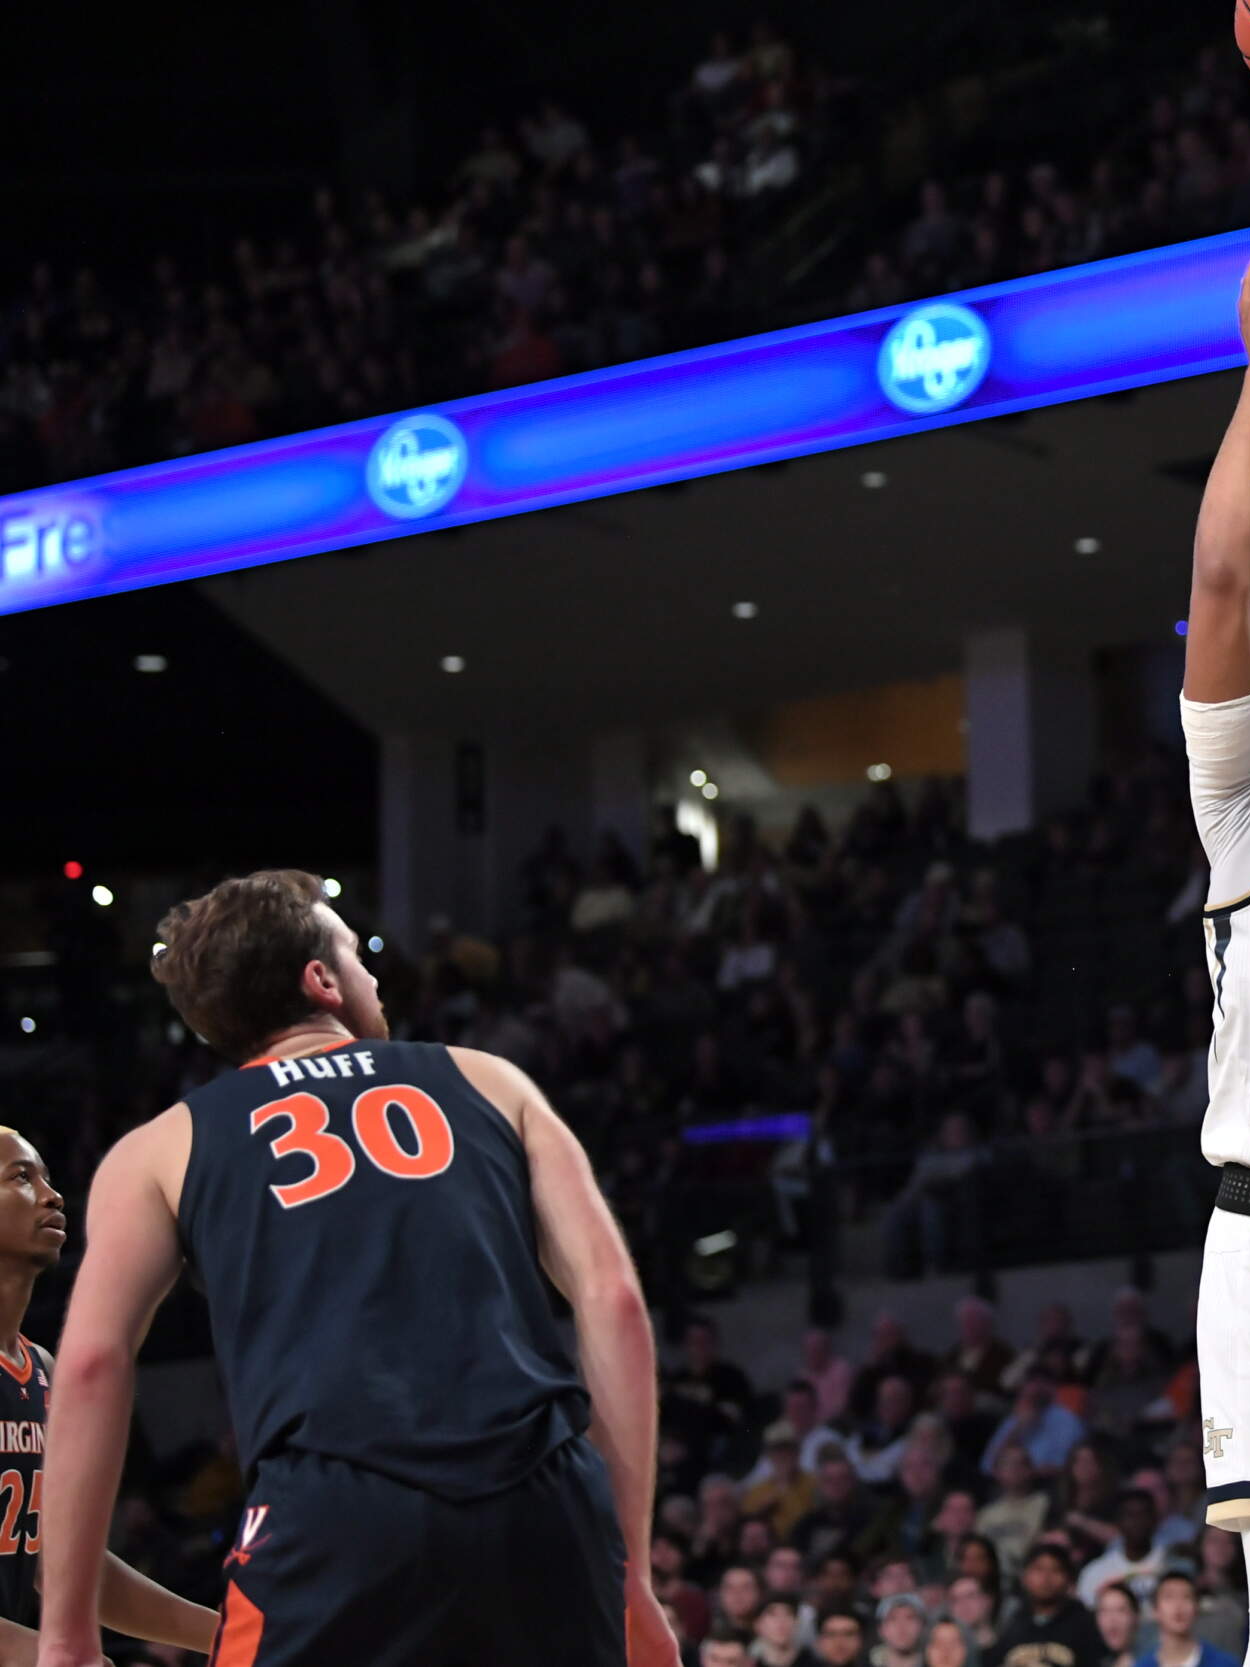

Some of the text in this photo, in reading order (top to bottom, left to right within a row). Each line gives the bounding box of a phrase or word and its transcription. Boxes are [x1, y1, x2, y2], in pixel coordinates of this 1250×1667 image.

[267, 1050, 376, 1088] HUFF
[250, 1083, 455, 1209] 30
[0, 1468, 43, 1556] 25
